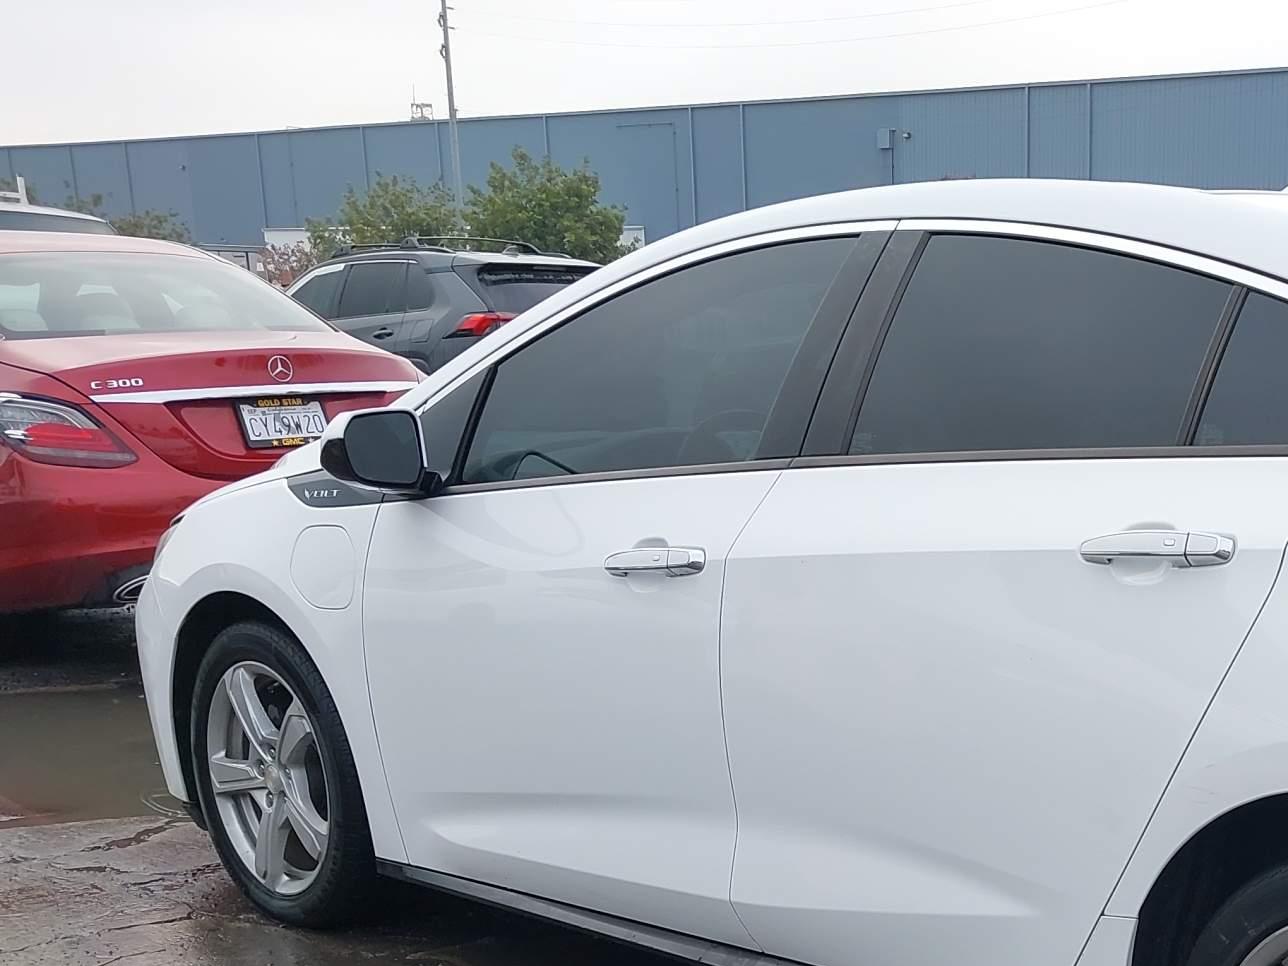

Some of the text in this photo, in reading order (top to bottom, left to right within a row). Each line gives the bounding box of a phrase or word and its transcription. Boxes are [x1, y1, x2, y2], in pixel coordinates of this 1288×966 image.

[90, 378, 144, 389] C 300
[257, 398, 303, 407] GOLD STAR
[249, 414, 324, 437] CY49W20
[281, 438, 305, 446] GMC
[304, 488, 341, 500] VOLT
